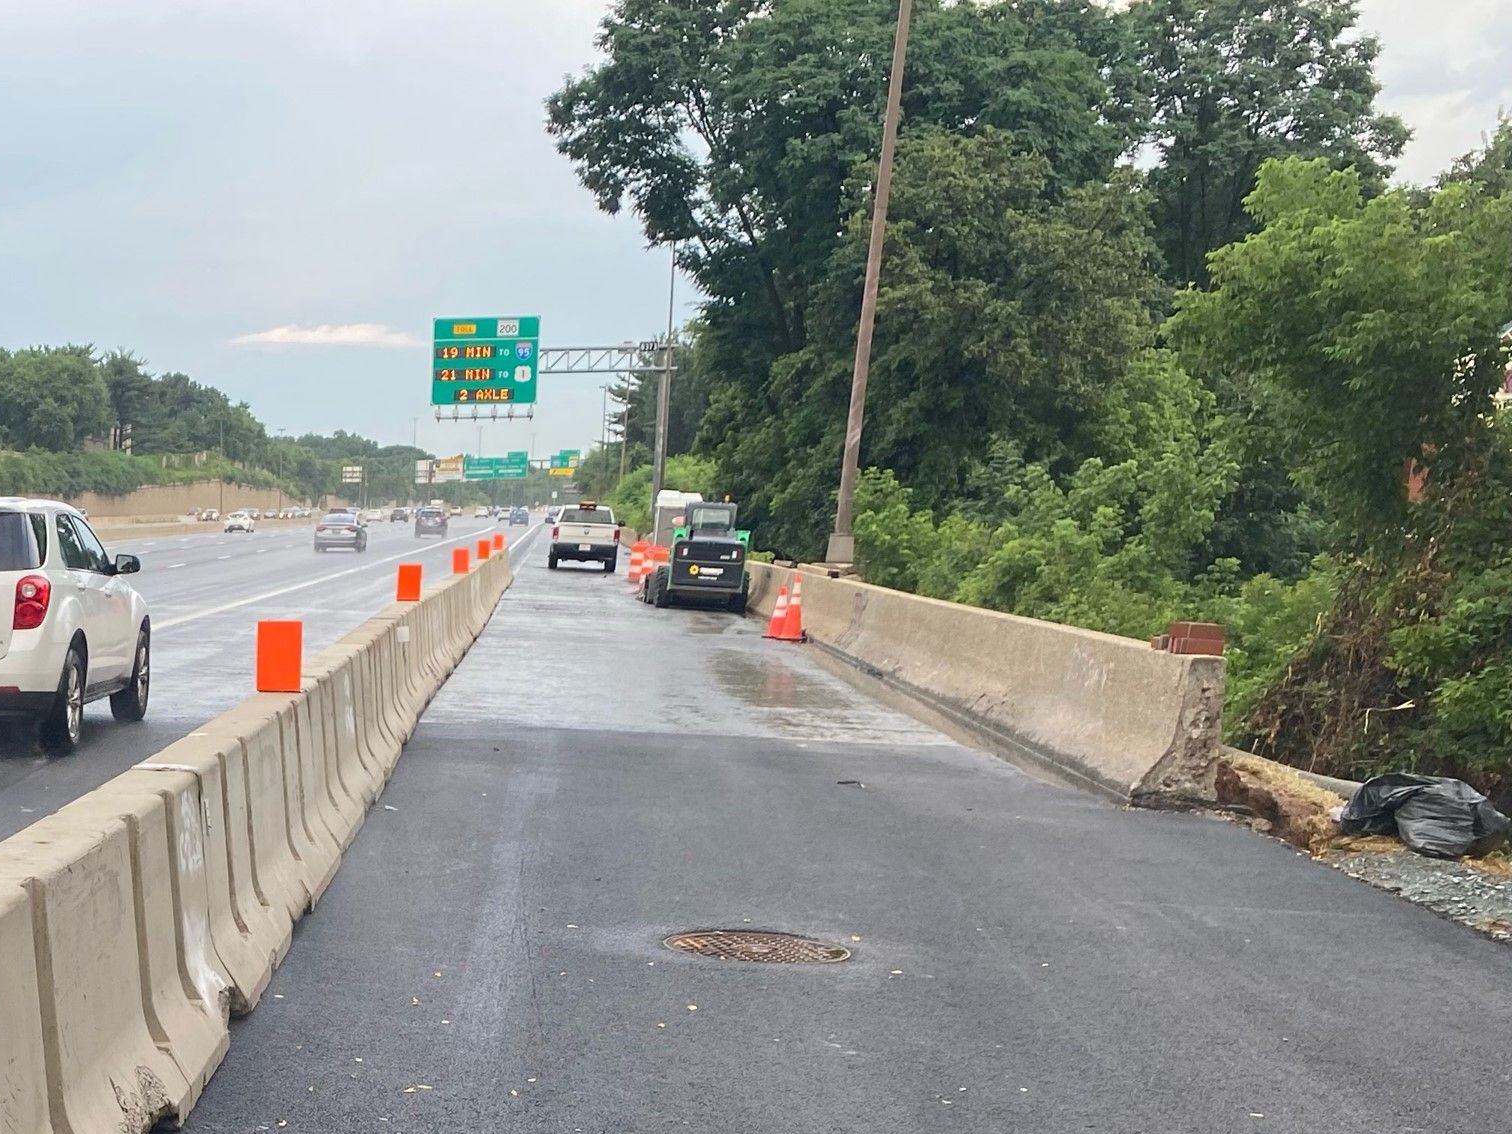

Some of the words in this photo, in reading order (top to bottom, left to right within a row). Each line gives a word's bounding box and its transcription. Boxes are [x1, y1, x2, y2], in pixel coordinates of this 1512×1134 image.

[499, 324, 517, 334] 200
[442, 347, 458, 358] 19
[466, 346, 491, 358] MIN
[499, 348, 510, 356] TO
[517, 348, 530, 357] 95
[441, 369, 456, 380] 21
[465, 368, 490, 380] MIN
[498, 370, 509, 378] TO
[459, 389, 468, 401] 2
[476, 388, 509, 400] AXLE
